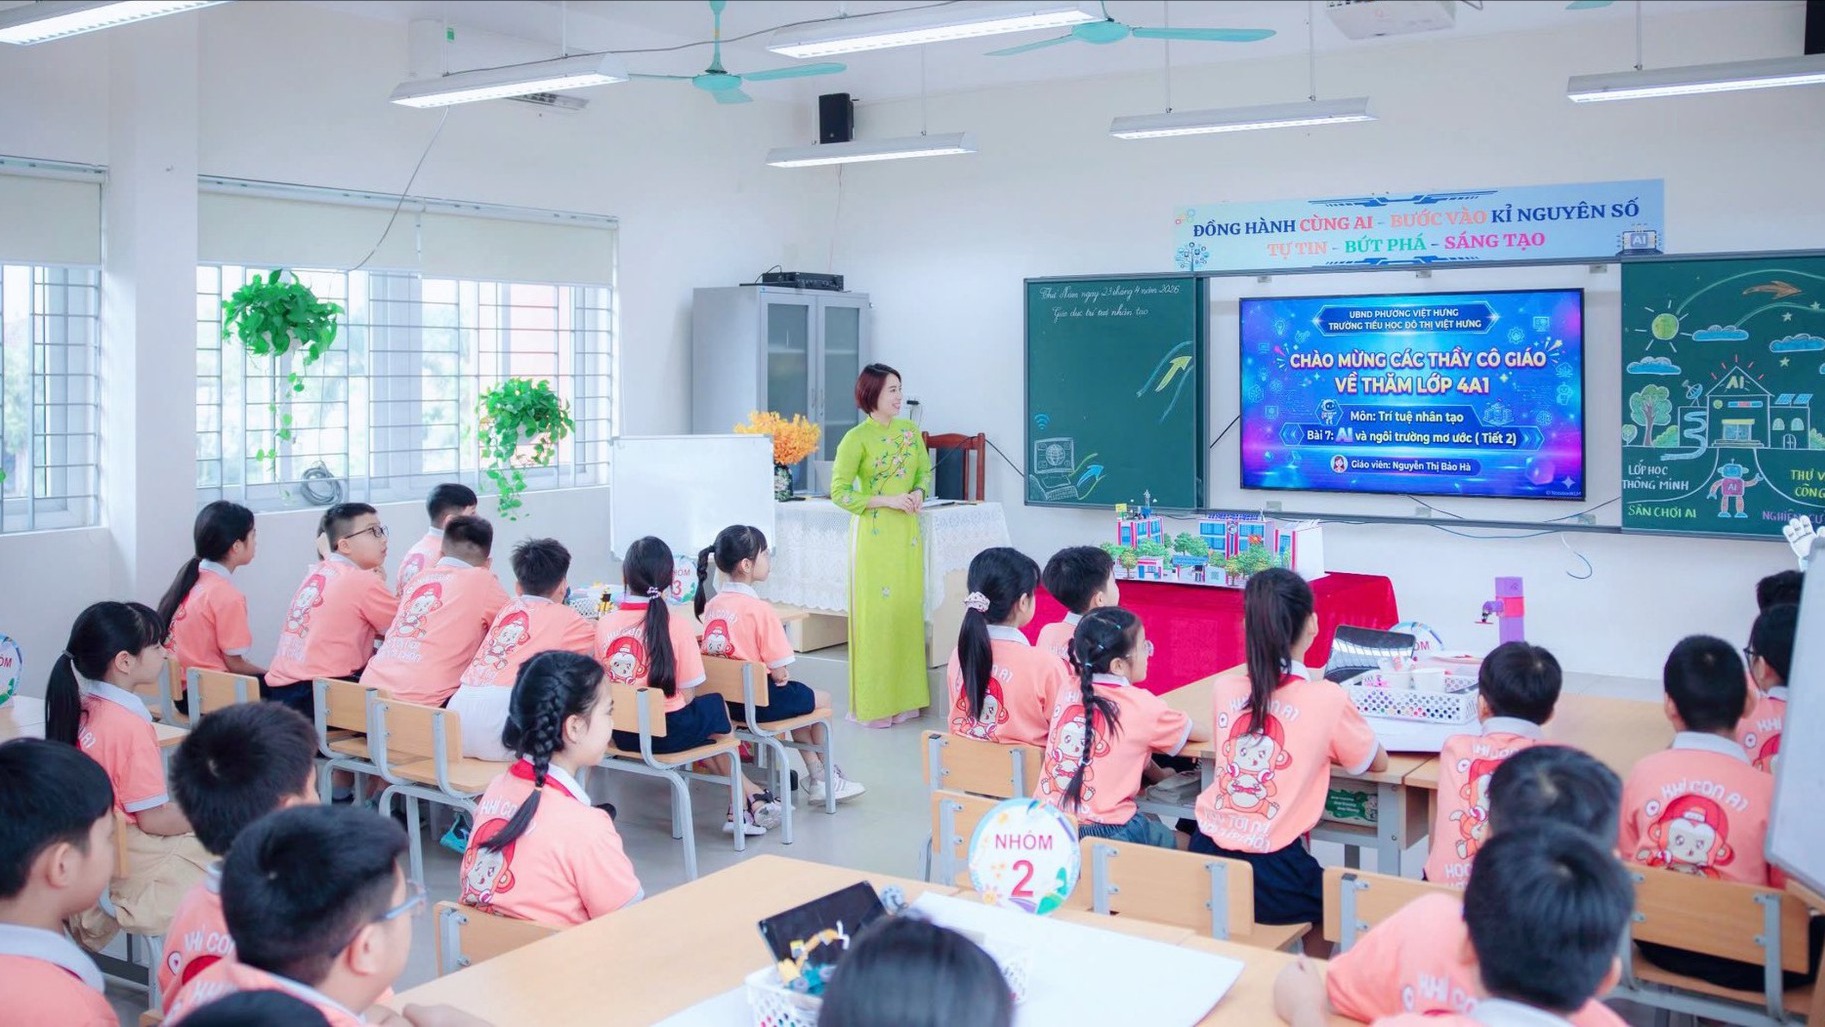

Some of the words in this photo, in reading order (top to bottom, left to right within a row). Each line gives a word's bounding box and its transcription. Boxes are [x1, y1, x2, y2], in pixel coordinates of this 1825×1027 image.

[1193, 220, 1241, 237] ĐỒNG
[1245, 217, 1296, 234] HÀNH
[1300, 214, 1350, 232] CÙNG
[1353, 215, 1373, 230] AI
[1390, 206, 1443, 228] BƯỚC
[1446, 206, 1487, 225] VÀO
[1492, 204, 1513, 223] KỈ
[1518, 201, 1605, 222] NGUYÊN
[1612, 197, 1640, 218] SỐ
[1267, 242, 1294, 260] TỰ
[1295, 241, 1328, 255] TIN
[1345, 235, 1383, 254] BỨT
[1387, 231, 1427, 252] PHÁ
[1444, 231, 1499, 250] SÁNG
[1503, 232, 1546, 252] TẠO
[1631, 234, 1647, 246] AI
[1101, 286, 1112, 297] 23
[1112, 285, 1133, 302] tháng
[1159, 284, 1180, 295] 2026
[1349, 310, 1373, 319] UBND
[1374, 307, 1411, 318] PHƯỜNG
[1413, 308, 1431, 318] VIỆT
[1434, 307, 1459, 317] HƯNG
[1328, 320, 1363, 331] TRƯỜNG
[1435, 319, 1454, 330] VIỆT
[1456, 318, 1482, 328] HƯNG
[1289, 349, 1334, 368] CHÀO
[1338, 348, 1387, 368] MỪNG
[1390, 347, 1425, 369] CÁC
[1428, 346, 1472, 368] THẦY
[1475, 347, 1501, 368] CÔ
[1504, 347, 1547, 367] GIÁO
[1334, 371, 1358, 394] VỀ
[1361, 372, 1413, 394] THĂM
[1416, 372, 1452, 394] LỚP
[1456, 377, 1490, 393] 4A1
[1726, 375, 1745, 390] AI
[1350, 411, 1376, 422] Môn:
[1378, 410, 1392, 422] Trí
[1394, 411, 1412, 424] tuệ
[1415, 411, 1443, 422] nhân
[1444, 412, 1464, 425] tạo
[1307, 429, 1323, 440] Bài
[1324, 430, 1334, 440] 7:
[1335, 427, 1353, 443] AI
[1355, 431, 1367, 441] và
[1369, 430, 1392, 444] ngôi
[1394, 431, 1430, 445] trường
[1433, 433, 1450, 443] mơ
[1452, 431, 1472, 443] ước
[1482, 432, 1503, 444] Tiết
[1506, 432, 1517, 446] 2)
[1351, 459, 1371, 469] Giáo
[1372, 460, 1391, 469] viên:
[1392, 460, 1424, 472] Nguyễn
[1426, 461, 1439, 472] Thị
[1441, 461, 1458, 471] Bảo
[1459, 461, 1471, 471] Hà
[1628, 459, 1647, 475] LỚP
[1647, 466, 1668, 478] HỌC
[1790, 468, 1815, 480] THƯ
[1623, 476, 1656, 490] THÔNG
[1659, 478, 1689, 491] MINH
[1727, 483, 1737, 491] AI
[1628, 503, 1652, 516] SÂN
[1653, 506, 1682, 518] CHƠI
[1684, 508, 1697, 518] AI
[671, 580, 682, 596] 3
[995, 829, 1053, 850] NHÓM
[1011, 859, 1034, 897] 2
